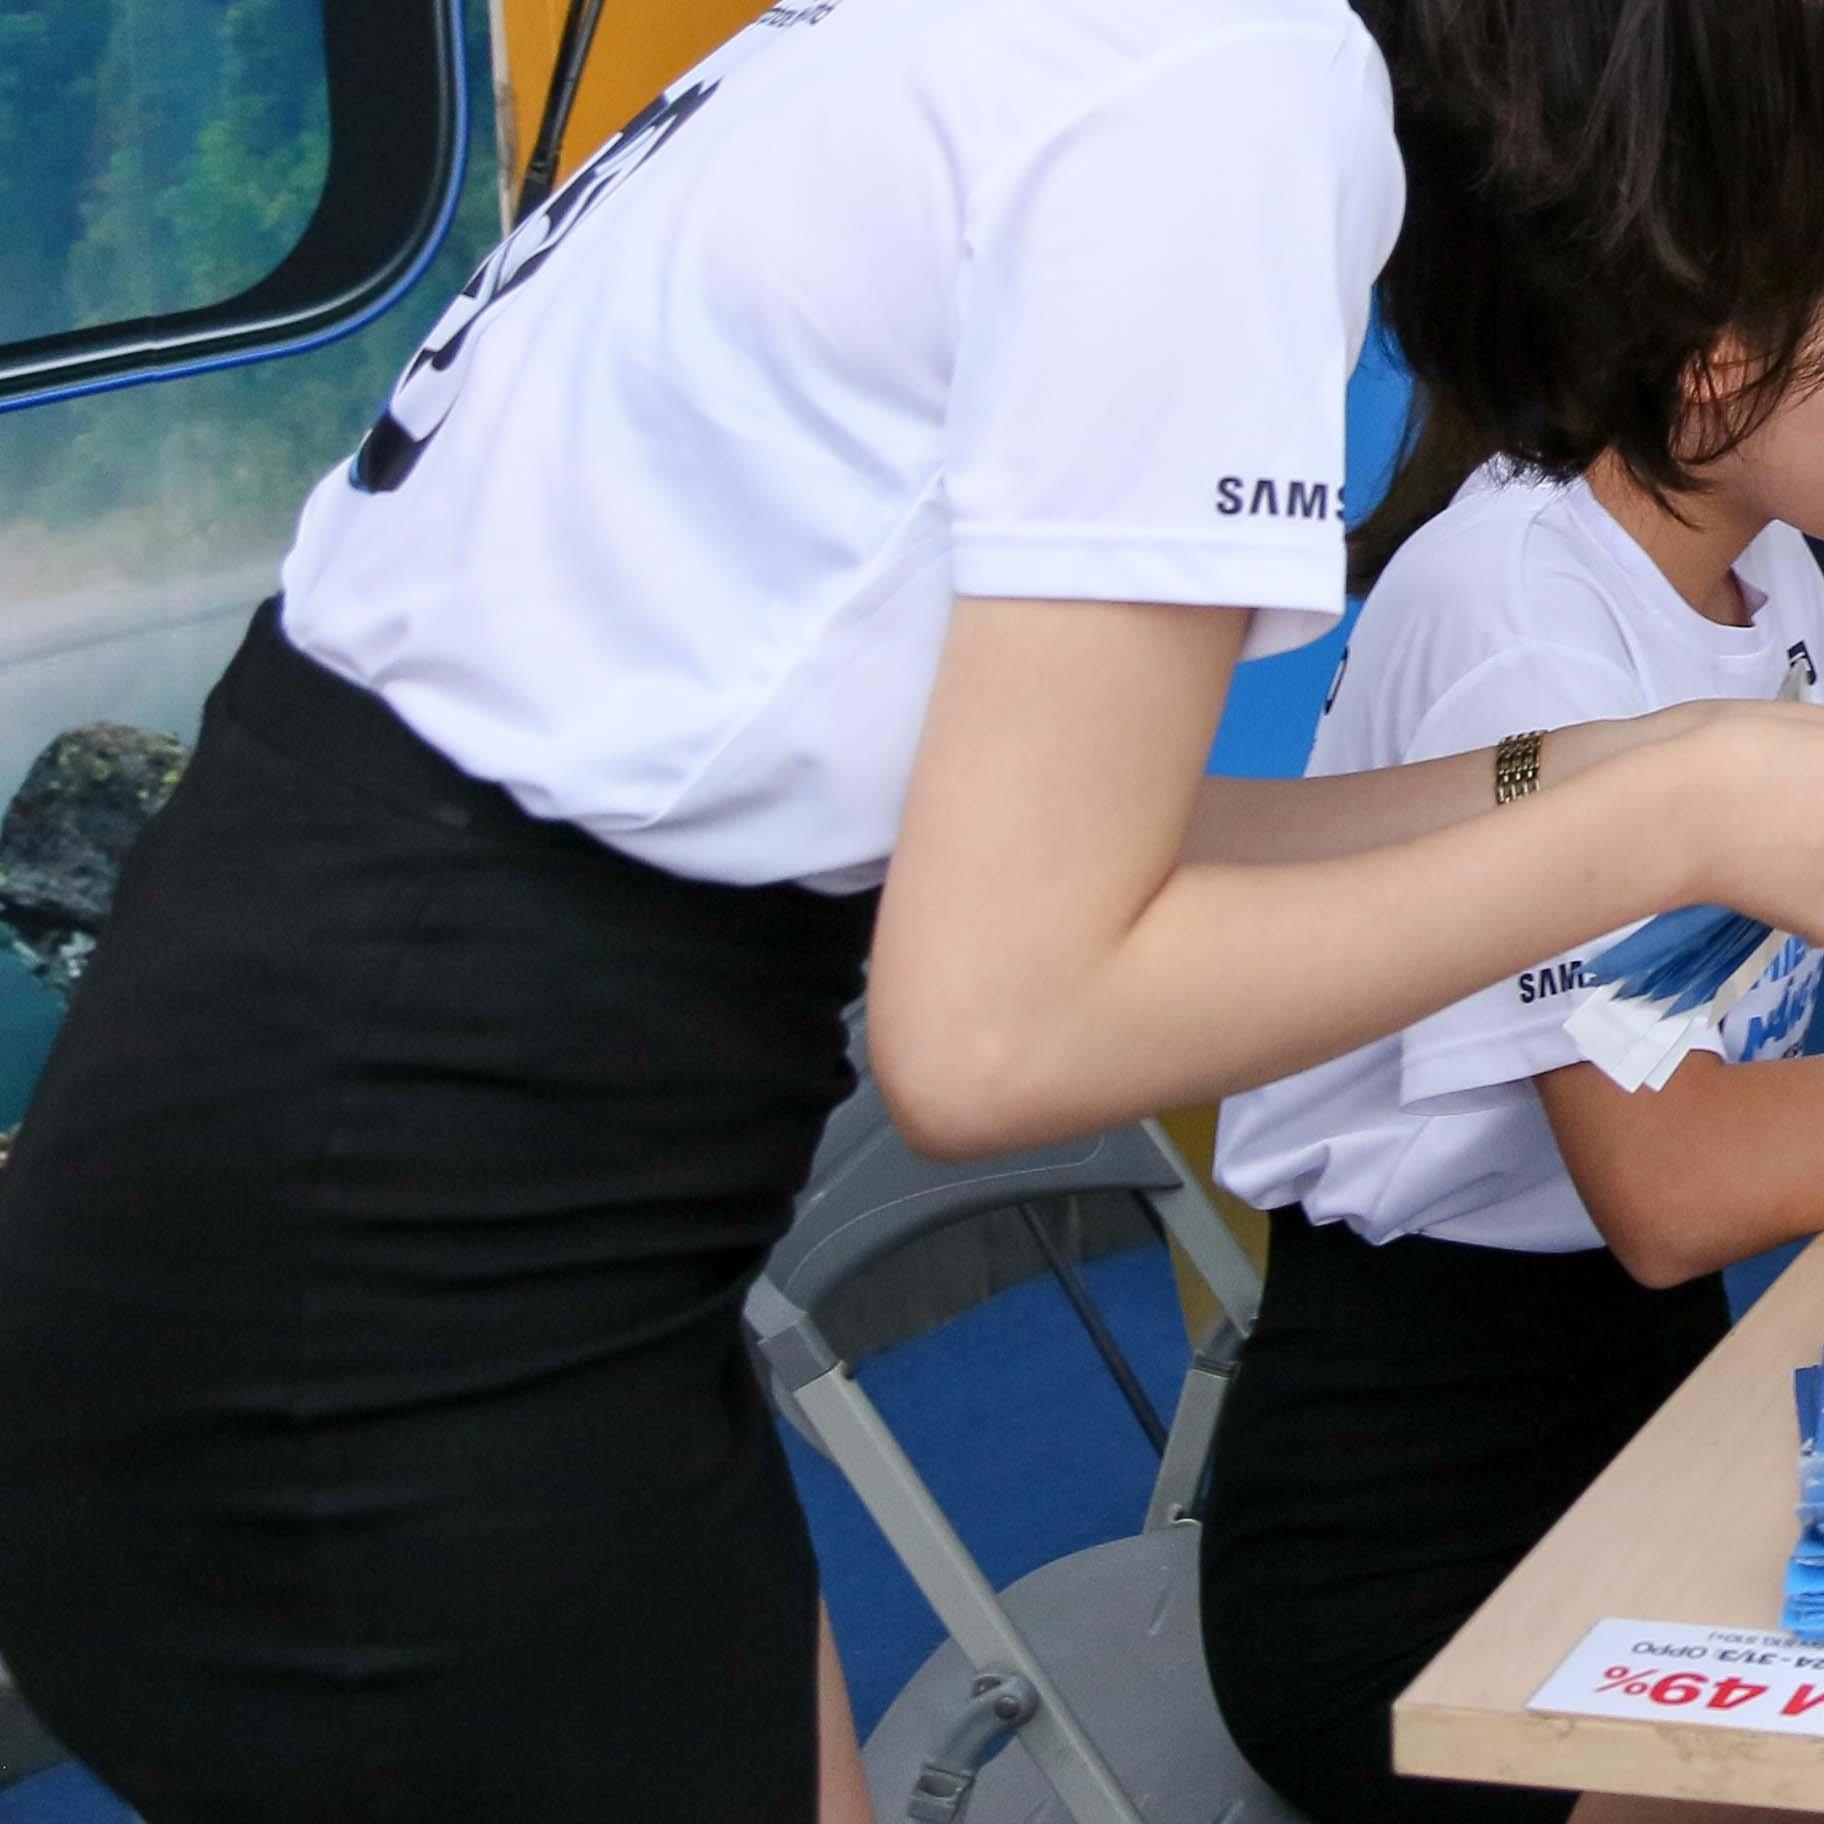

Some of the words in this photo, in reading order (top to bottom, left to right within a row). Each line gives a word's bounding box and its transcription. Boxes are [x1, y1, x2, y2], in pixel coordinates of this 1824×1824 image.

[1631, 1640, 1707, 1660] OPPO
[1714, 1649, 1779, 1667] 31/3:
[1594, 1664, 1771, 1711] 49%
